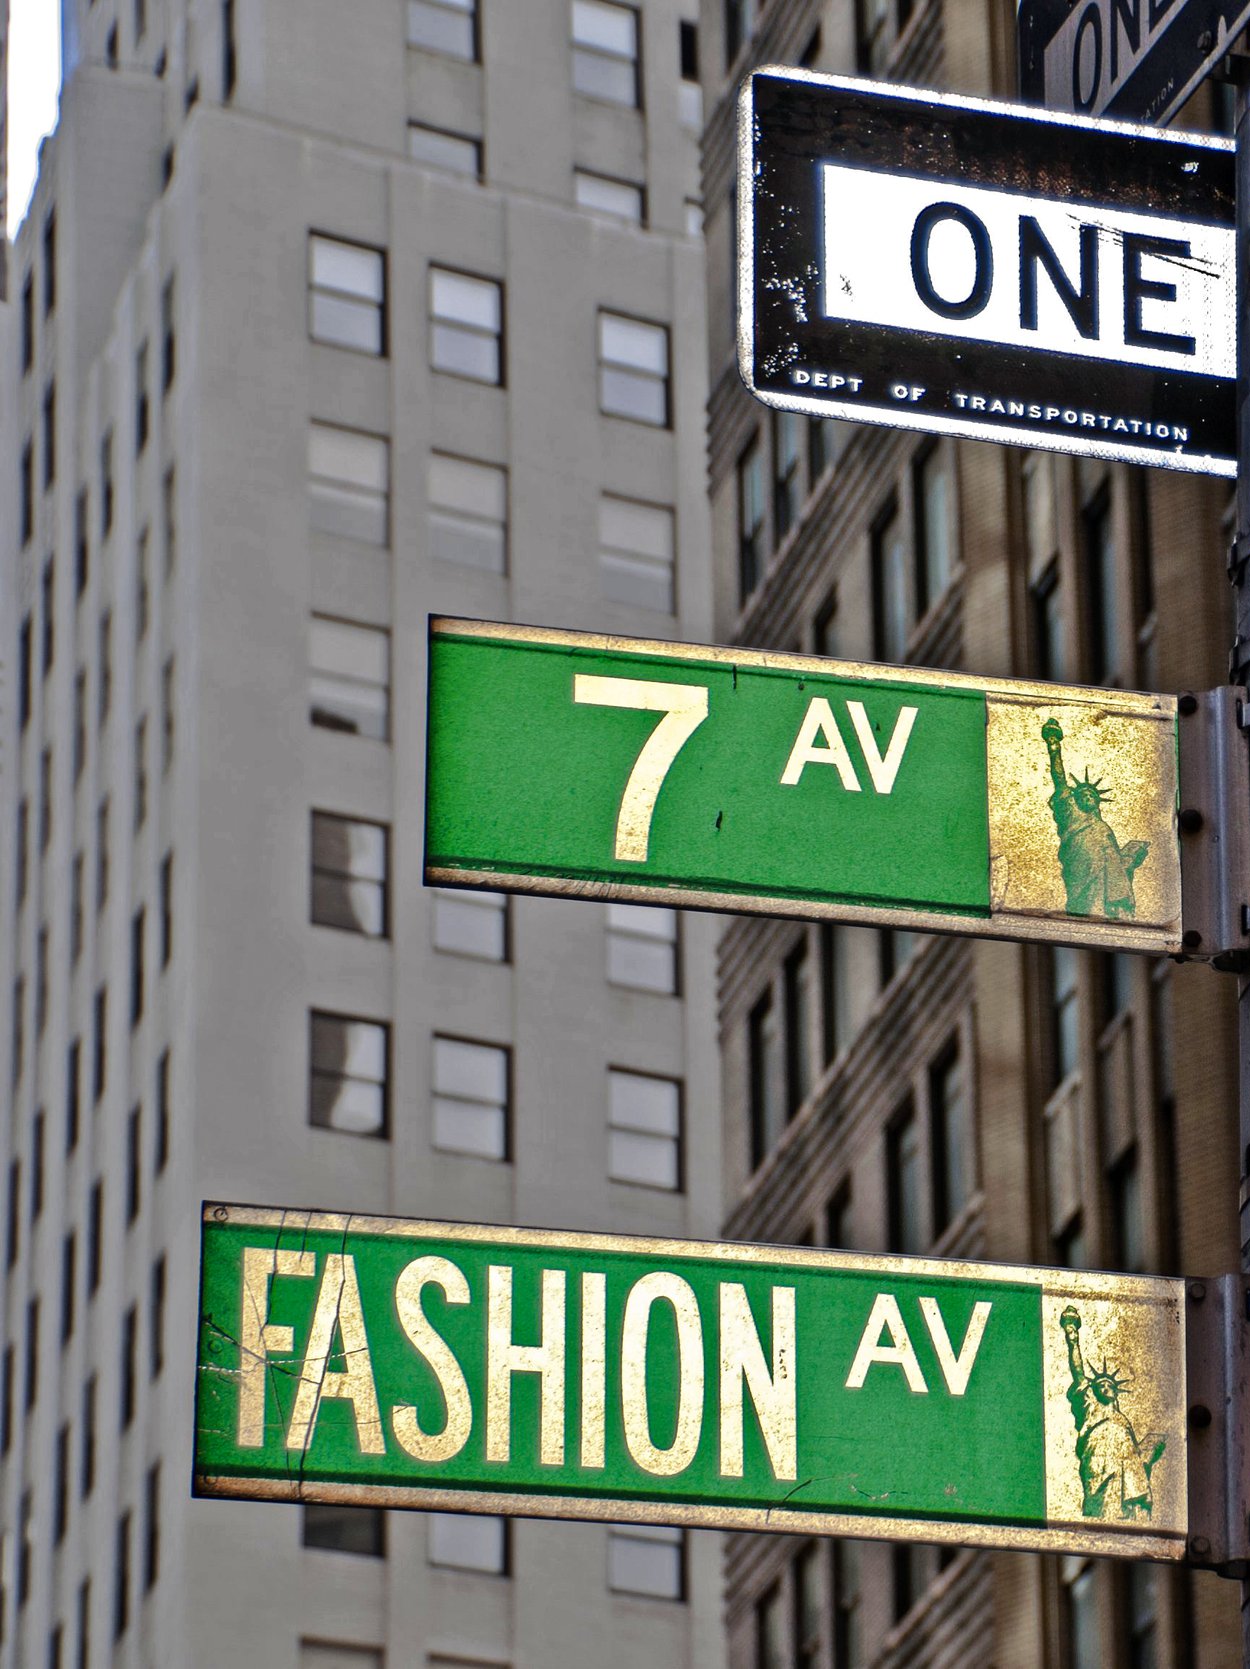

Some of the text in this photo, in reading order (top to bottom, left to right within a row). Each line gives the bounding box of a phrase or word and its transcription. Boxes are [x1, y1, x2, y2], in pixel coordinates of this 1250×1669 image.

[910, 201, 1196, 356] ONE
[792, 369, 1189, 442] DEPT OF TRANSPORTATION
[574, 673, 919, 862] 7 AV
[237, 1247, 993, 1480] FASHION AV
